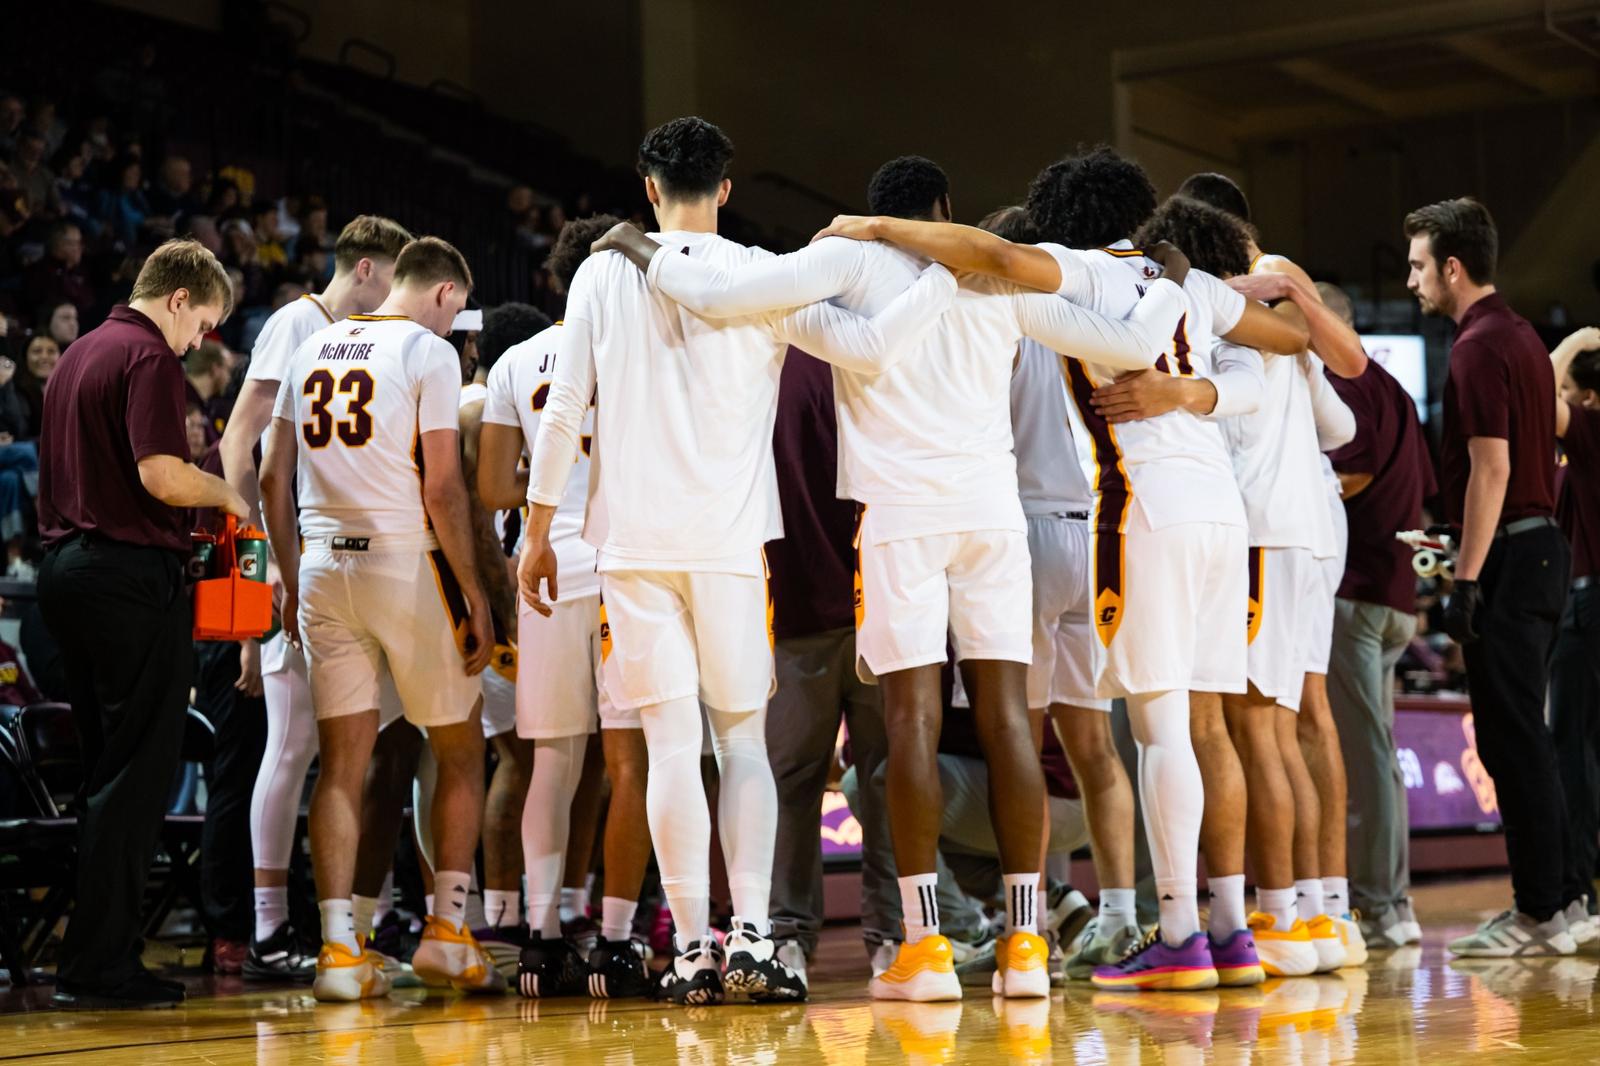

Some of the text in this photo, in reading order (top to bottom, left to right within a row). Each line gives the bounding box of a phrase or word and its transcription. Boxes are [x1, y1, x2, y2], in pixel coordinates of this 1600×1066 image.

[317, 343, 376, 360] McINTIRE
[538, 353, 557, 373] J
[302, 367, 375, 450] 33
[239, 553, 258, 577] G
[1100, 606, 1118, 623] C
